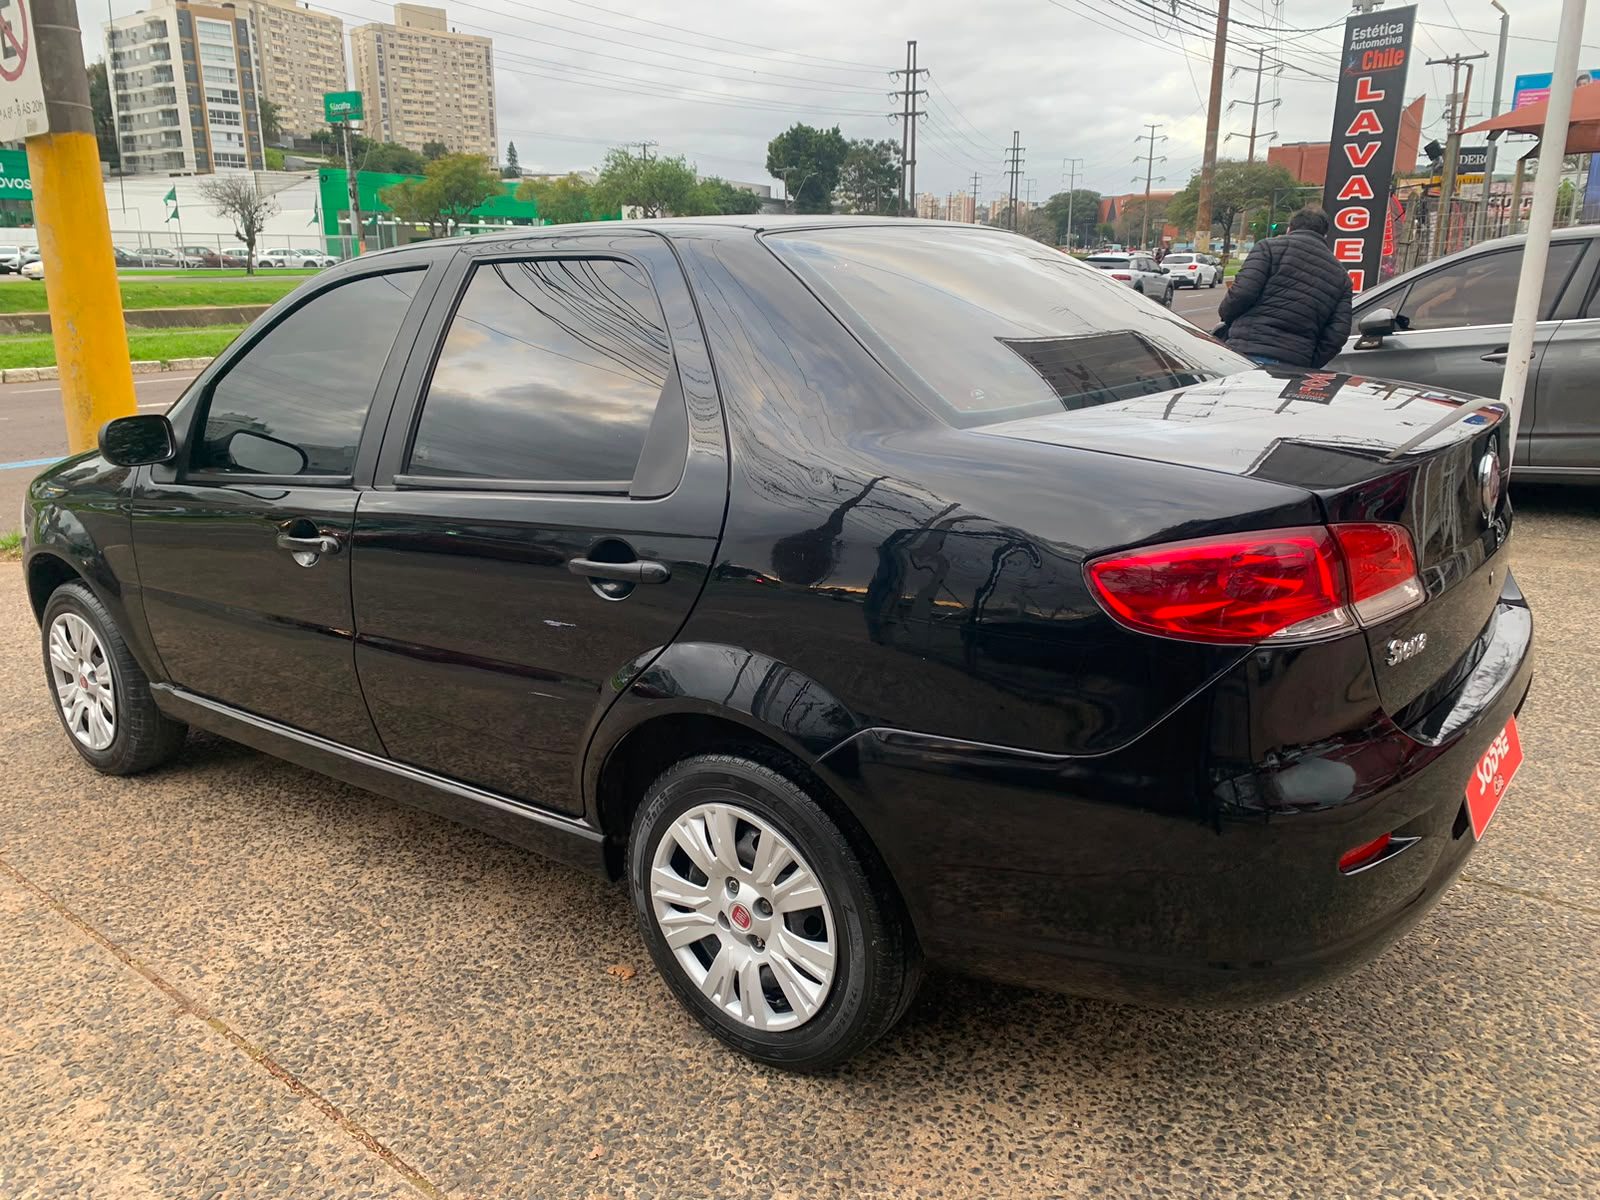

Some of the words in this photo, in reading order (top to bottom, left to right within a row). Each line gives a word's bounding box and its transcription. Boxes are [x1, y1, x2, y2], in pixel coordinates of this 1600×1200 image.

[1352, 22, 1404, 41] Estética
[1350, 36, 1403, 51] Automotiva
[1362, 47, 1405, 71] Chile
